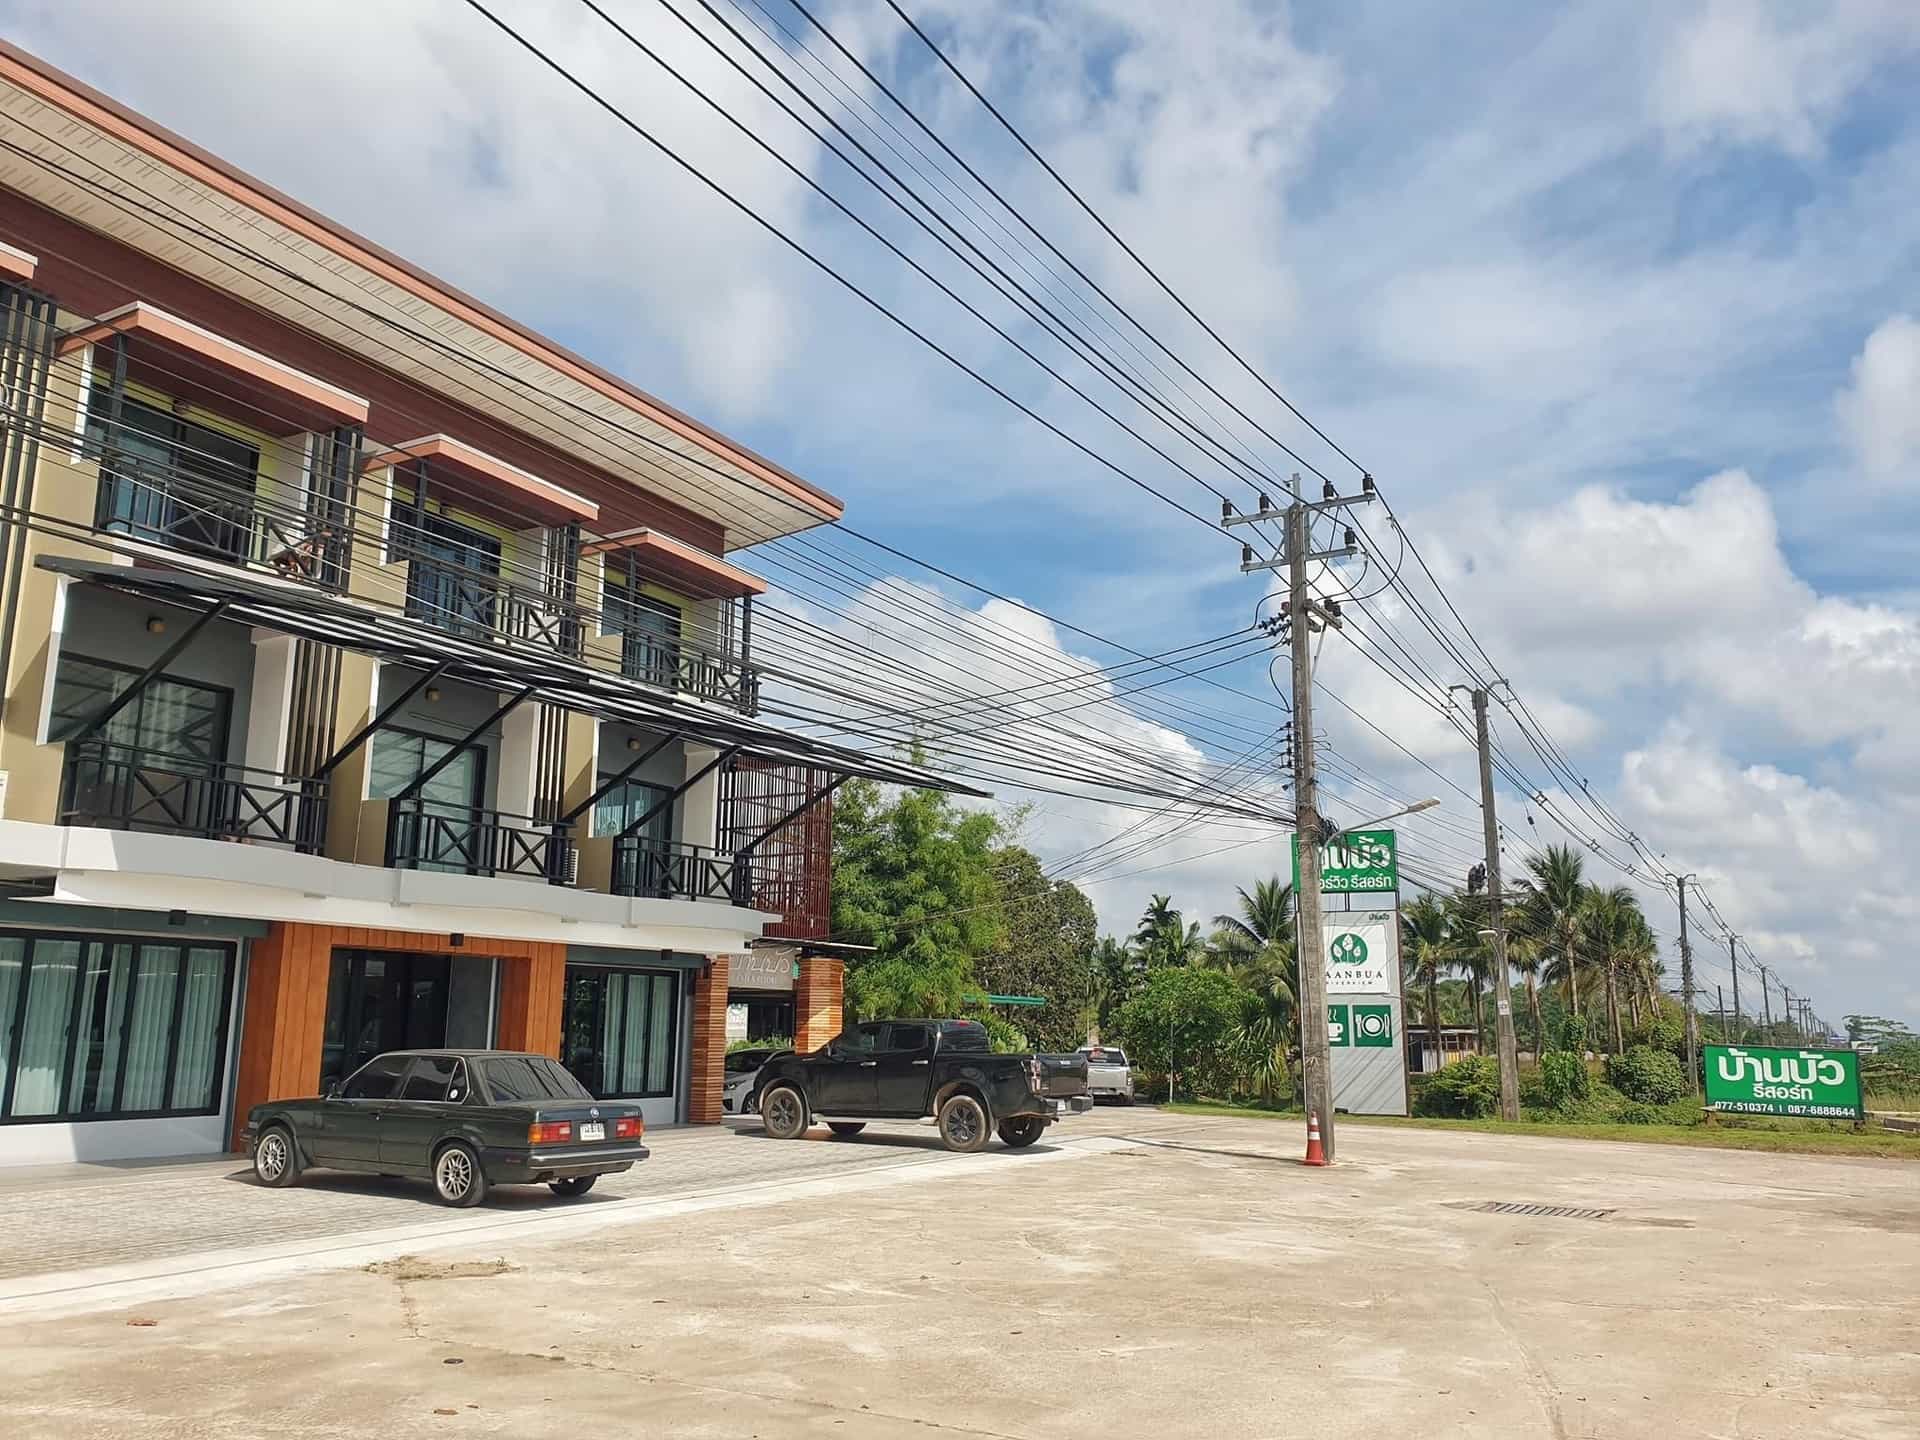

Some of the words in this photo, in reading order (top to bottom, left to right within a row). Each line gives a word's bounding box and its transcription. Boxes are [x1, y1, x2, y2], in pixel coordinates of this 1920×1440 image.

[1325, 970, 1383, 979] AANBUA
[1718, 1048, 1846, 1086] บ้านบัว
[1753, 1083, 1814, 1101] รีสอร์ท
[1714, 1101, 1774, 1113] 077-510374
